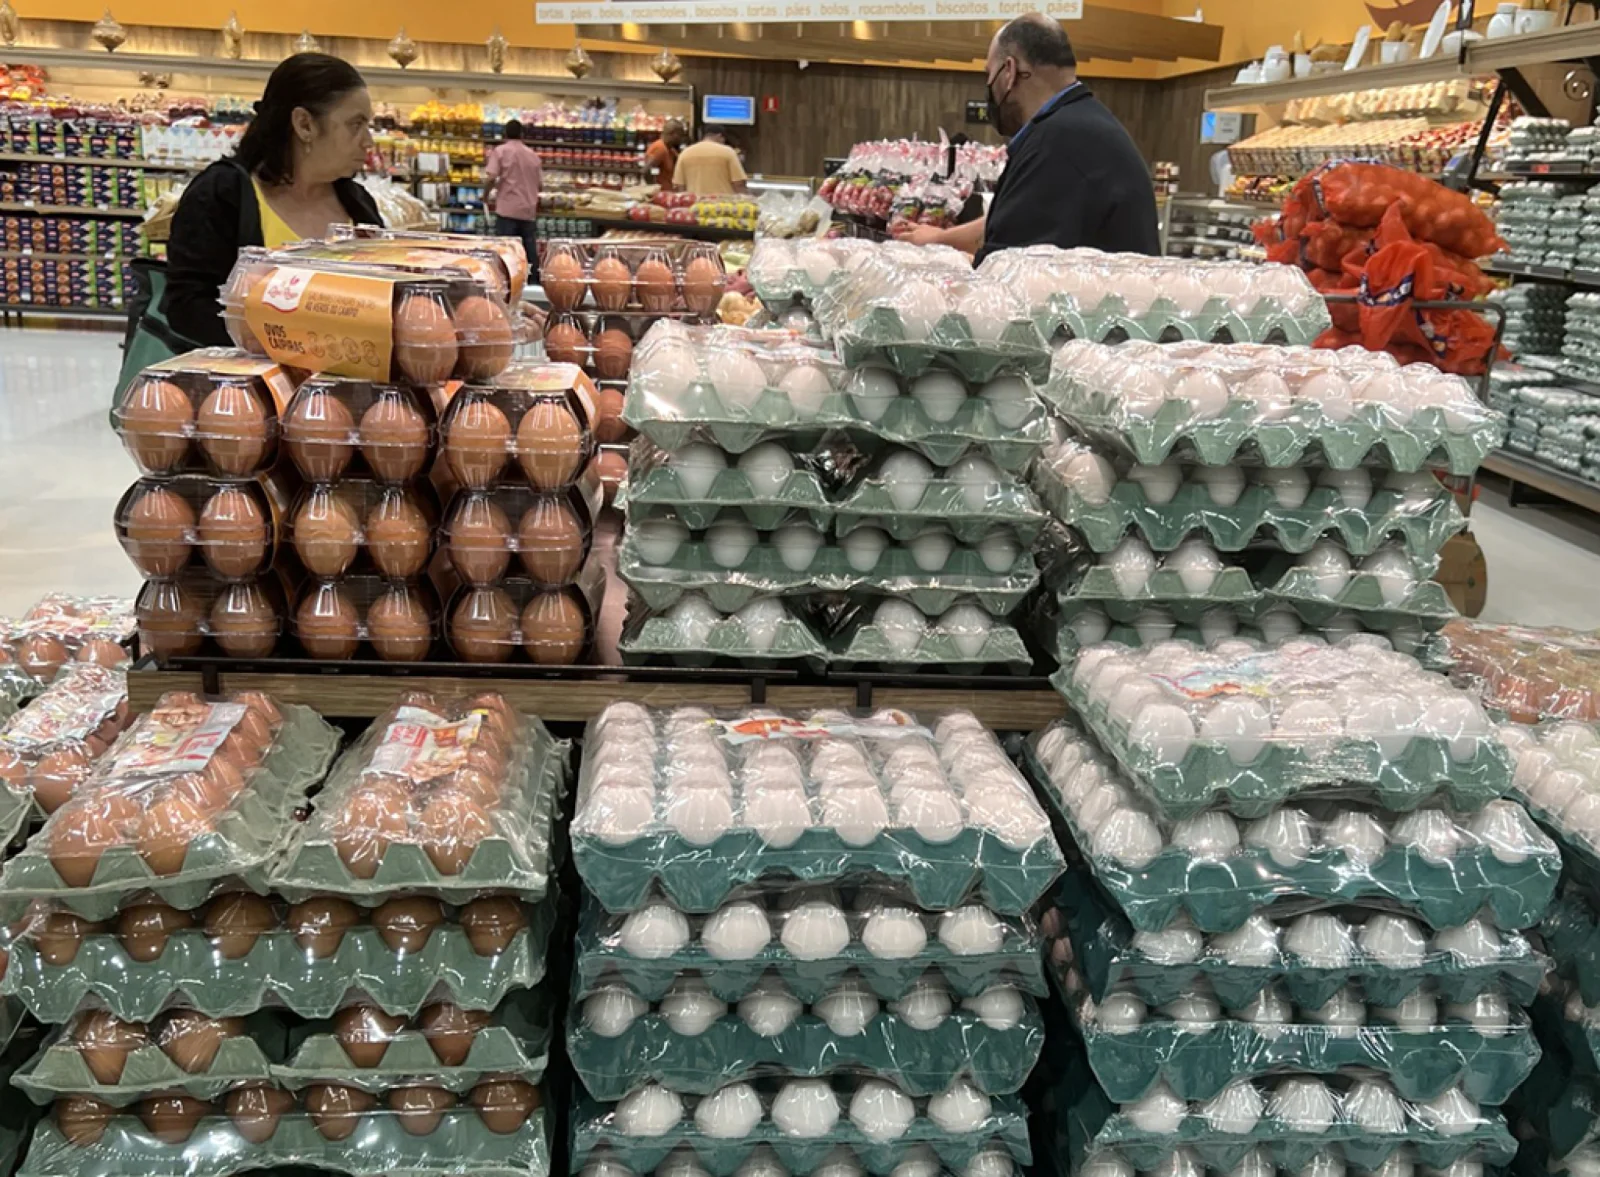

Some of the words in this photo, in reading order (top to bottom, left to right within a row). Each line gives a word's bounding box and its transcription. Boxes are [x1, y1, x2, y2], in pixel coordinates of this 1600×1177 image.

[746, 5, 777, 17] tortas
[820, 3, 849, 16] bolos
[858, 3, 925, 15] rocamboles
[935, 1, 989, 14] biscoitos
[999, 1, 1036, 13] tortas
[263, 322, 287, 338] OVOS
